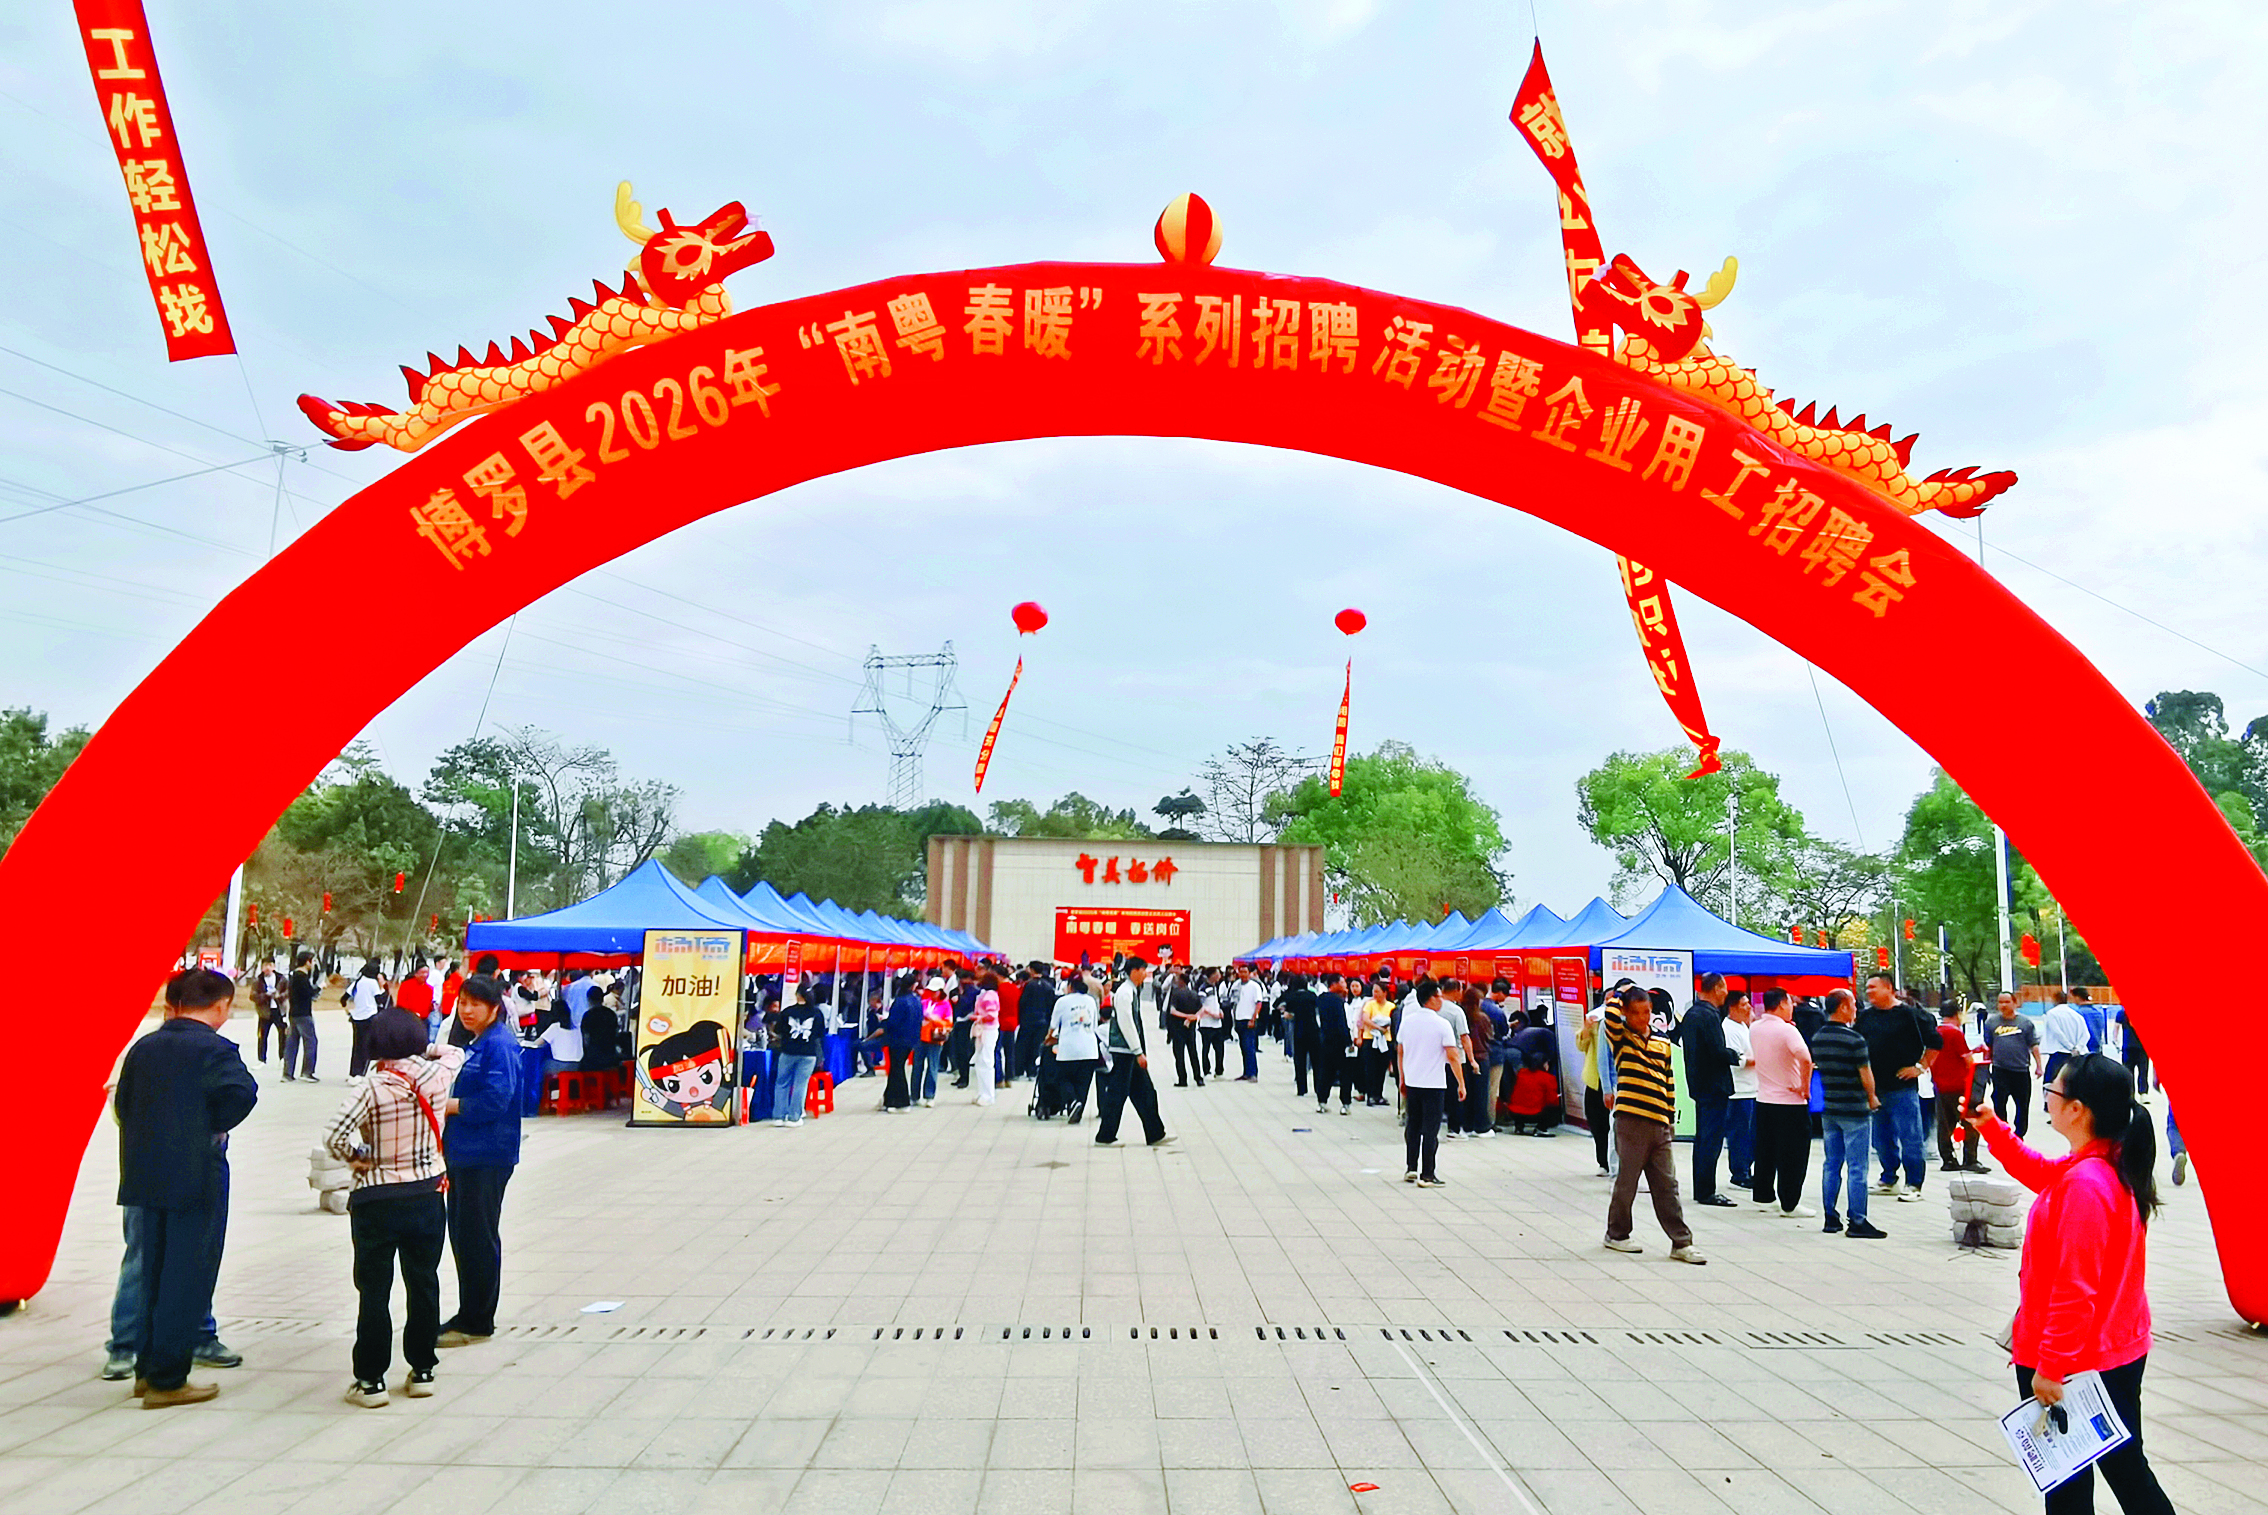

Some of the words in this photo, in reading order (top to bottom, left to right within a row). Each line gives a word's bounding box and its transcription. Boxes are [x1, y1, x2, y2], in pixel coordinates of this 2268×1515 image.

[91, 27, 215, 338] 工作轻松找
[661, 975, 720, 997] 加油!
